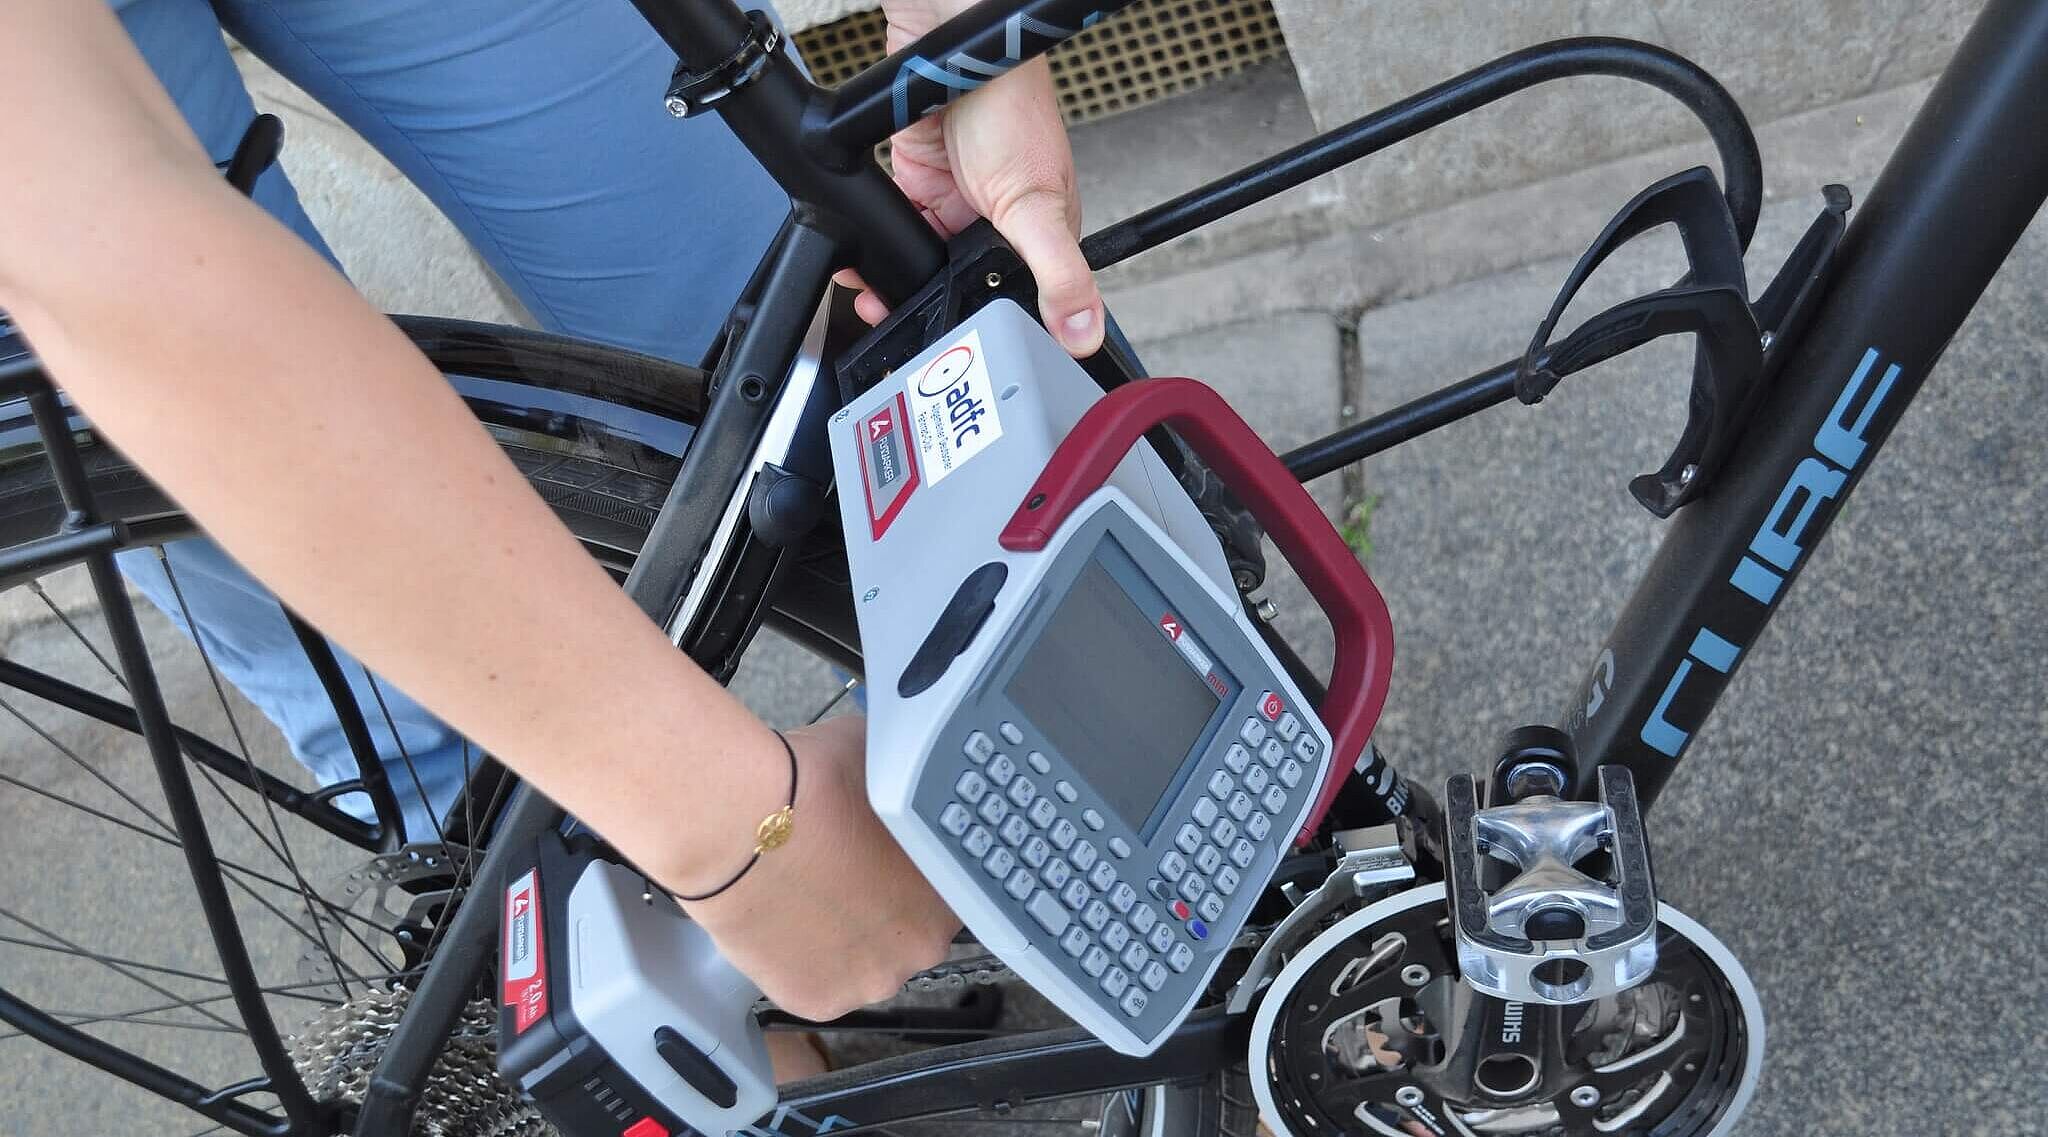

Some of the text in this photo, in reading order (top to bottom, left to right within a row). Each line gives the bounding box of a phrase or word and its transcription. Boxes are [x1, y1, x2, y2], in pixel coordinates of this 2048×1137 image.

[946, 381, 985, 448] adfc
[1206, 671, 1229, 698] mini
[1501, 1001, 1524, 1043] SHIM
